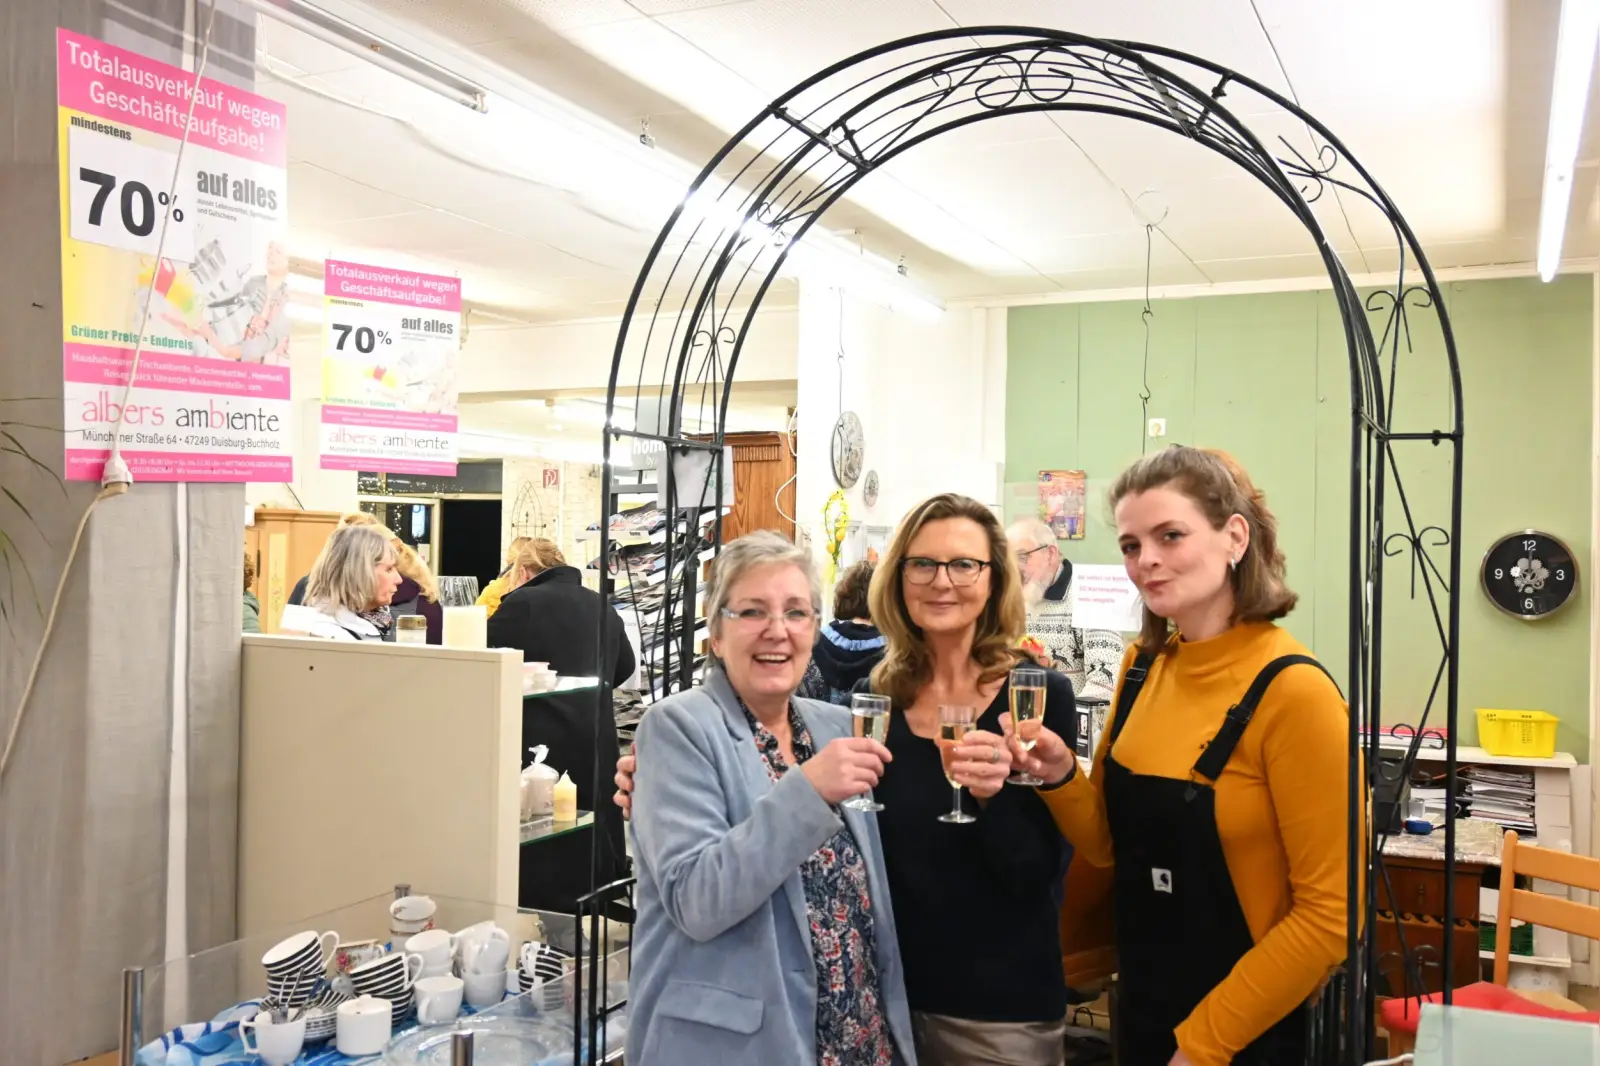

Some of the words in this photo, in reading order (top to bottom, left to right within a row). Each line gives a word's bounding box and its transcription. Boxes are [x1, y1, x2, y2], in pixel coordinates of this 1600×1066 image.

[66, 40, 223, 111] Totalausverkauf
[228, 98, 281, 130] wegen
[70, 115, 132, 141] mindestens
[89, 81, 265, 152] Geschäftsaufgabe!
[79, 167, 184, 237] 70%
[197, 170, 228, 198] auf
[232, 178, 278, 211] alles
[330, 264, 420, 286] Totalausverkauf
[422, 279, 457, 293] wegen
[340, 281, 446, 305] Geschäftsaufgabe!
[71, 324, 109, 340] Grüner
[111, 330, 140, 344] Preis
[150, 335, 194, 350] Endpreis
[401, 317, 421, 331] auf
[423, 319, 454, 334] alles
[331, 323, 393, 354] 70%
[82, 391, 165, 427] albers
[175, 399, 280, 432] ambiente
[82, 430, 134, 443] Münchner
[135, 432, 165, 444] Straße
[166, 435, 177, 444] 64
[184, 436, 210, 446] 47249
[211, 436, 280, 450] Duisburg-Buchholz
[329, 427, 377, 445] albers
[383, 431, 449, 450] ambiente
[633, 437, 667, 454] hom
[1522, 540, 1537, 551] 12
[1494, 568, 1504, 580] 9
[1555, 569, 1565, 581] 3
[1524, 597, 1533, 609] 6
